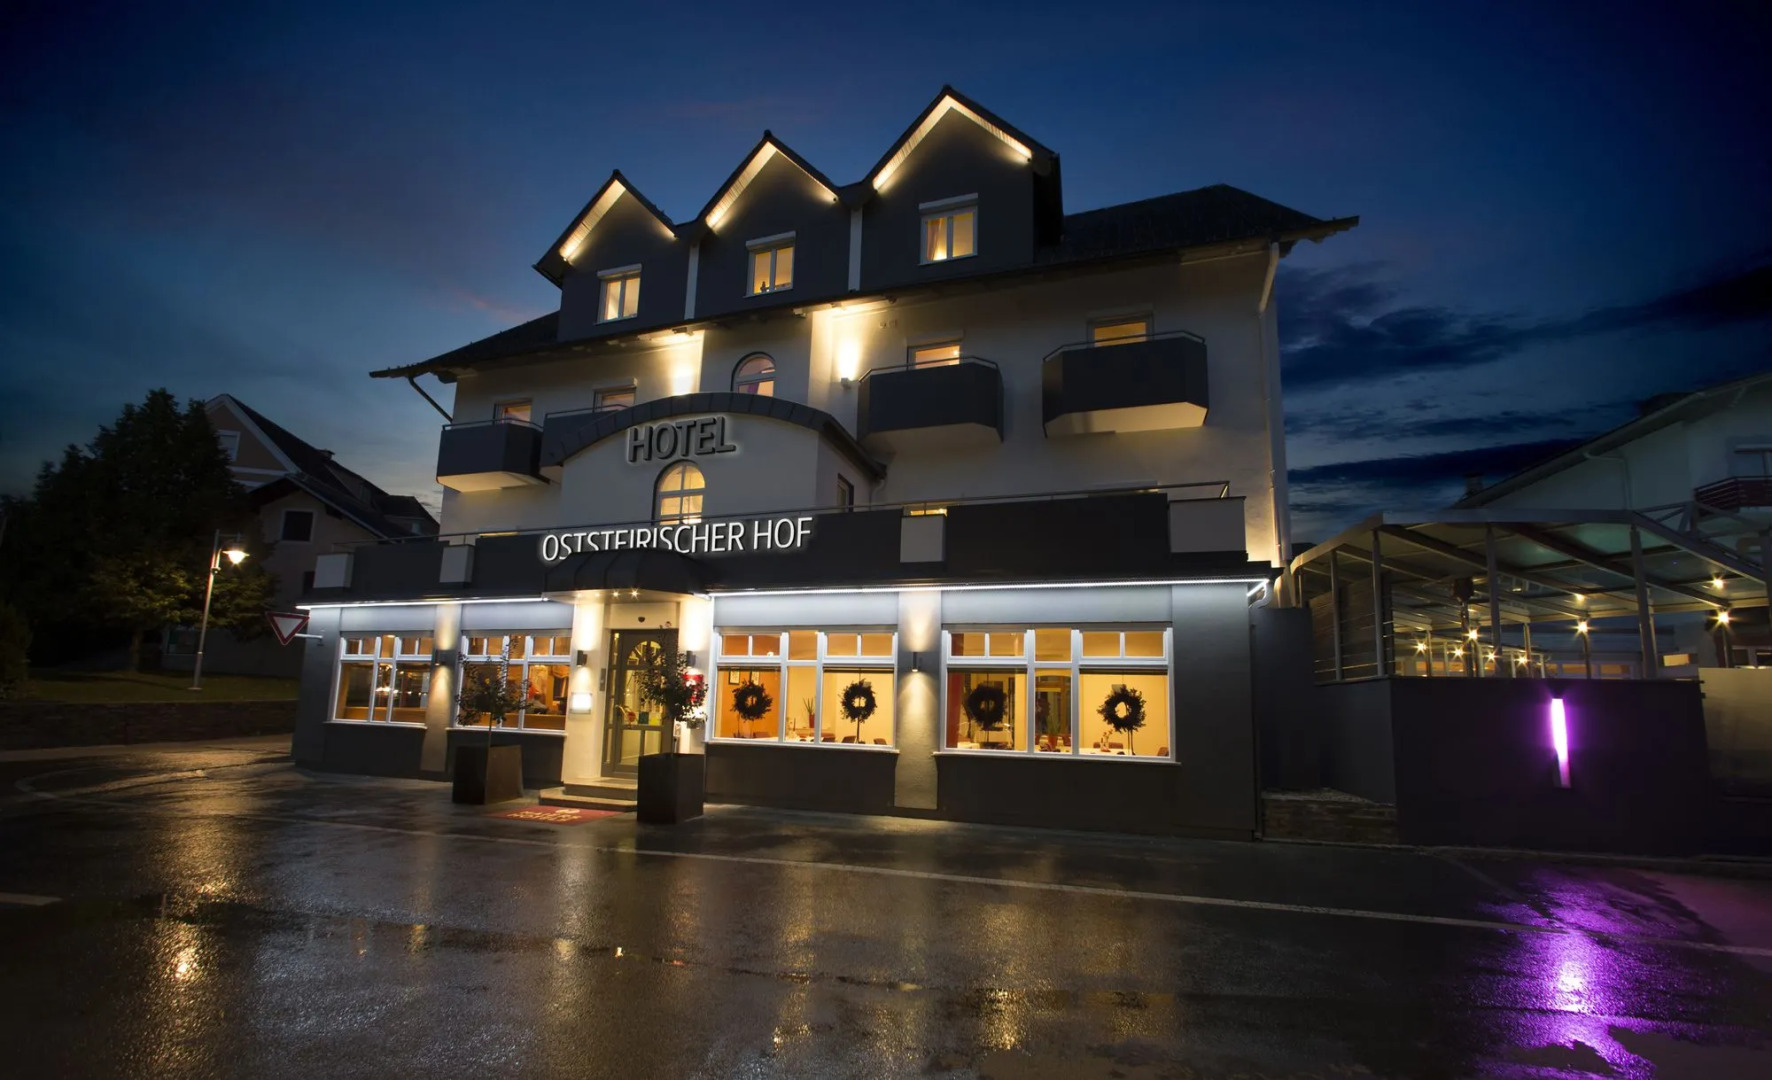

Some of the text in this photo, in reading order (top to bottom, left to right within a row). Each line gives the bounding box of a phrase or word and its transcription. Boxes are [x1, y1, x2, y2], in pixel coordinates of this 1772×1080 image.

[627, 416, 737, 463] HOTEL
[542, 516, 813, 561] OSTSTEIRISCHER HOF
